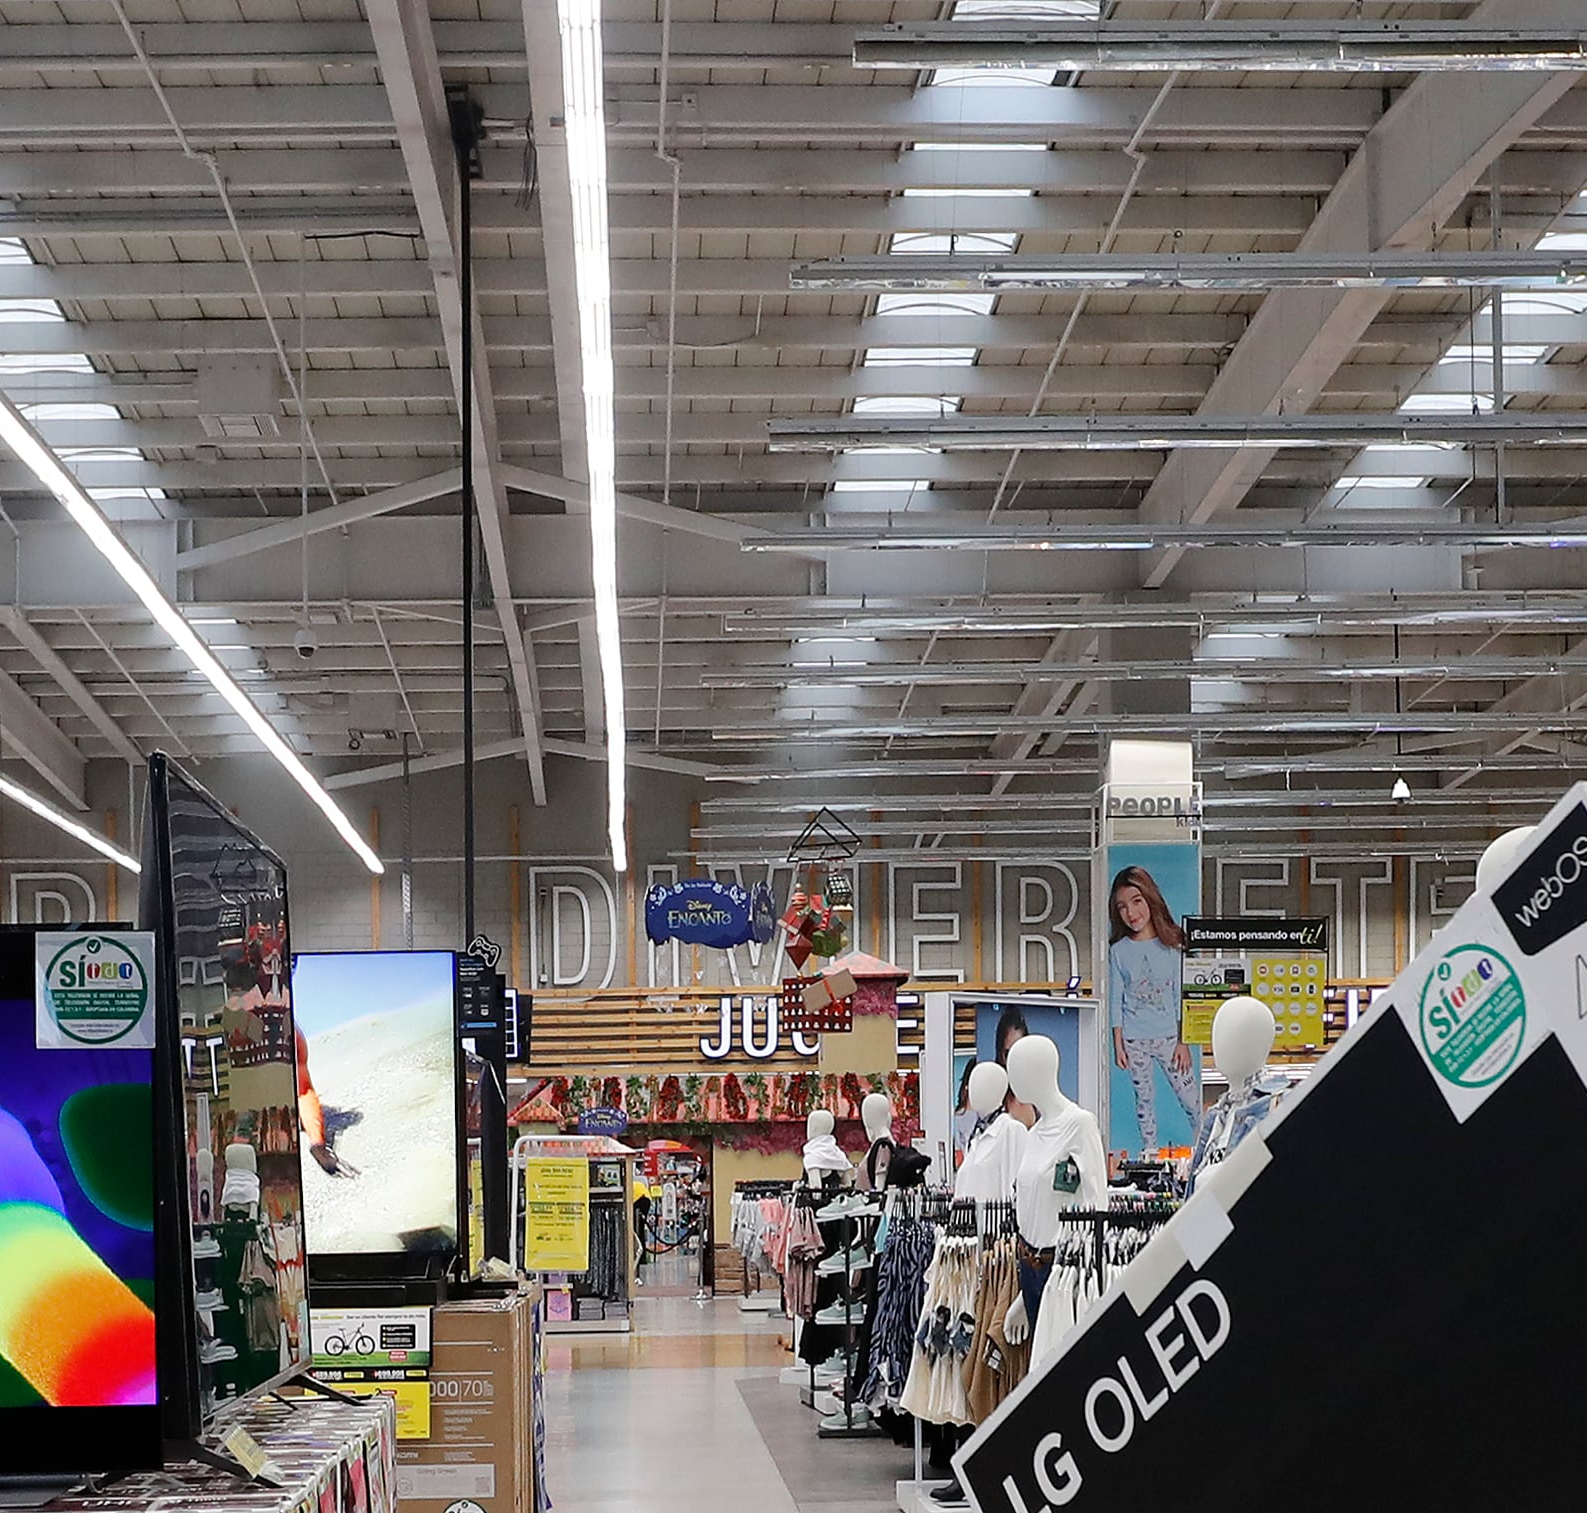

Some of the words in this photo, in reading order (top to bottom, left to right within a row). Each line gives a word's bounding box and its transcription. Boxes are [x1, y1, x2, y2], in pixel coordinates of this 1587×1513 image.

[1190, 930, 1237, 941] ¡Estamos
[1239, 930, 1288, 943] pensando
[1084, 1279, 1231, 1453] OLED
